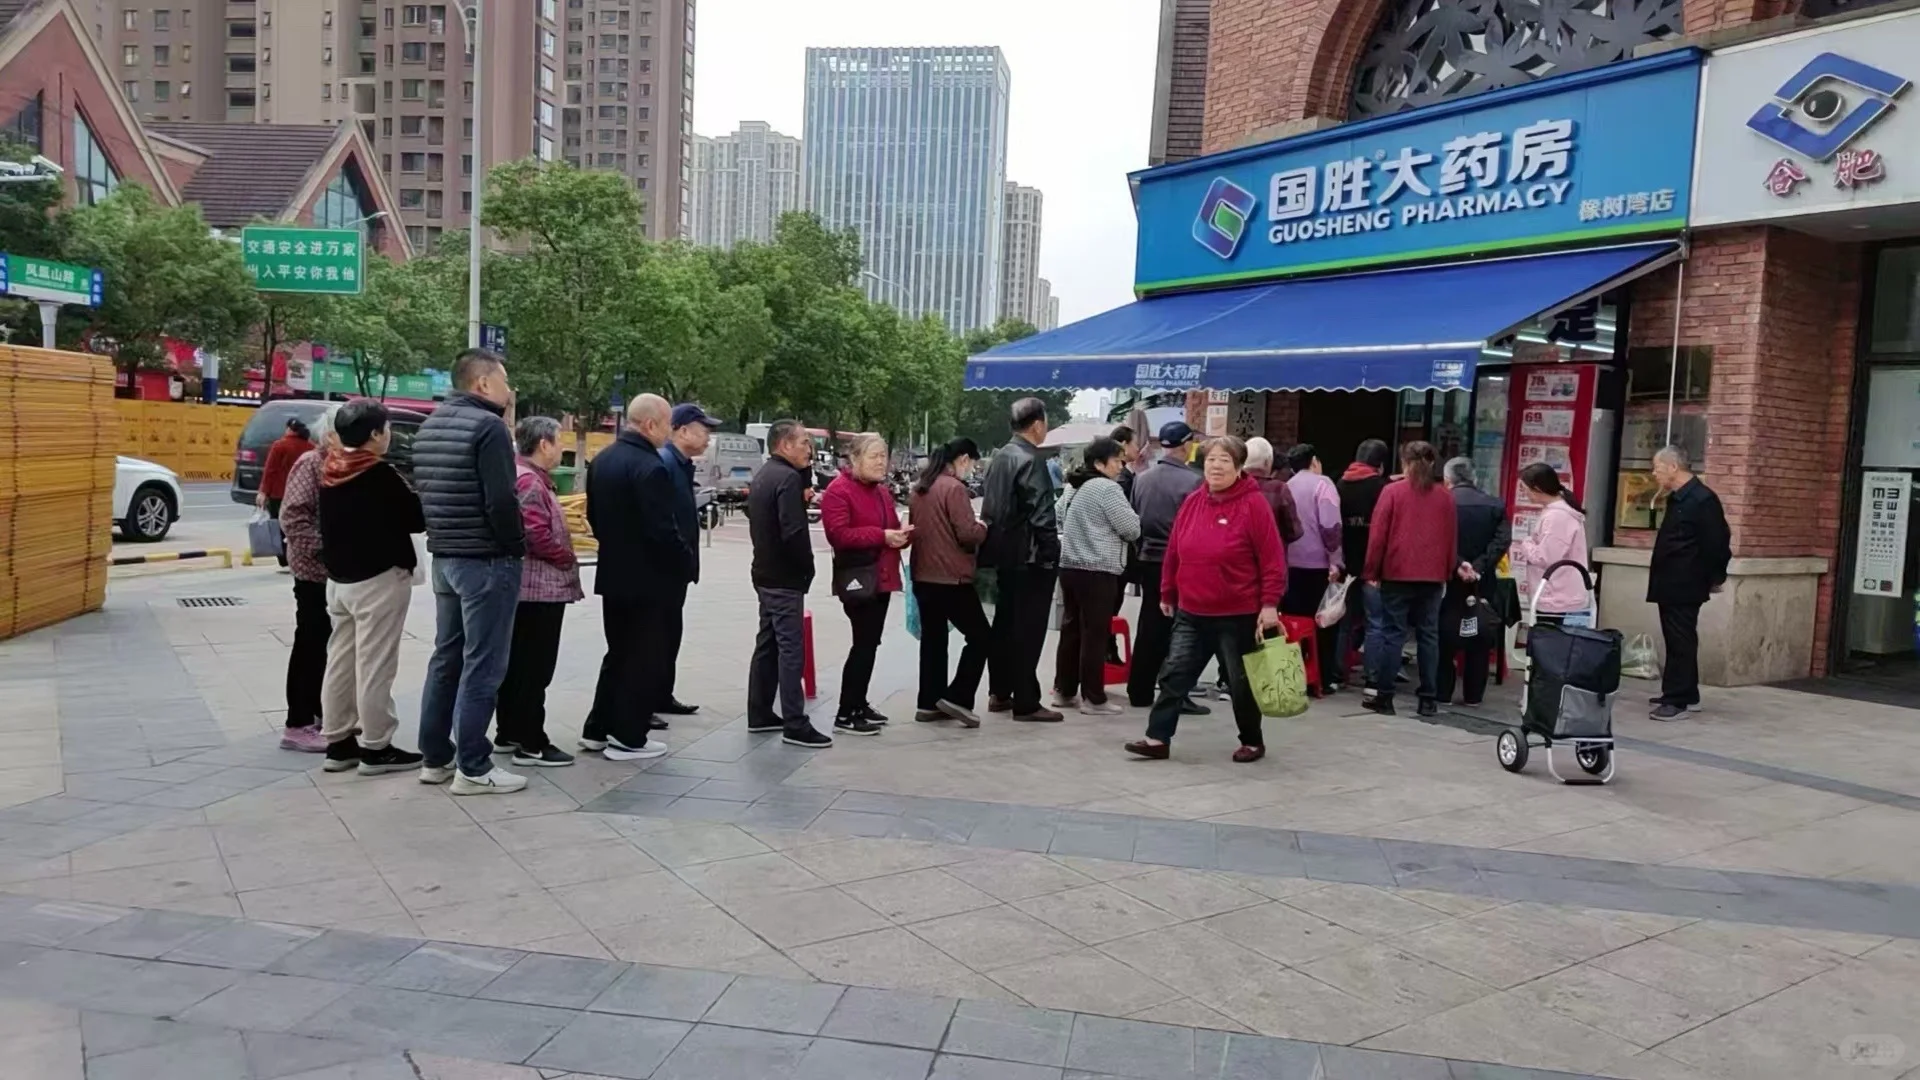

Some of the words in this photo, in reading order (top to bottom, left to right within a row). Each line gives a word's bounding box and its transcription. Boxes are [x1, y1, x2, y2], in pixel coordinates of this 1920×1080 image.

[1268, 208, 1391, 243] GUOSHENG
[1402, 181, 1570, 225] PHARMACY
[1579, 188, 1675, 221] 橡树湾店
[247, 240, 356, 256] 交通安全进万家
[247, 264, 355, 281] 出入平安你我他
[1135, 363, 1201, 379] 国胜大药房
